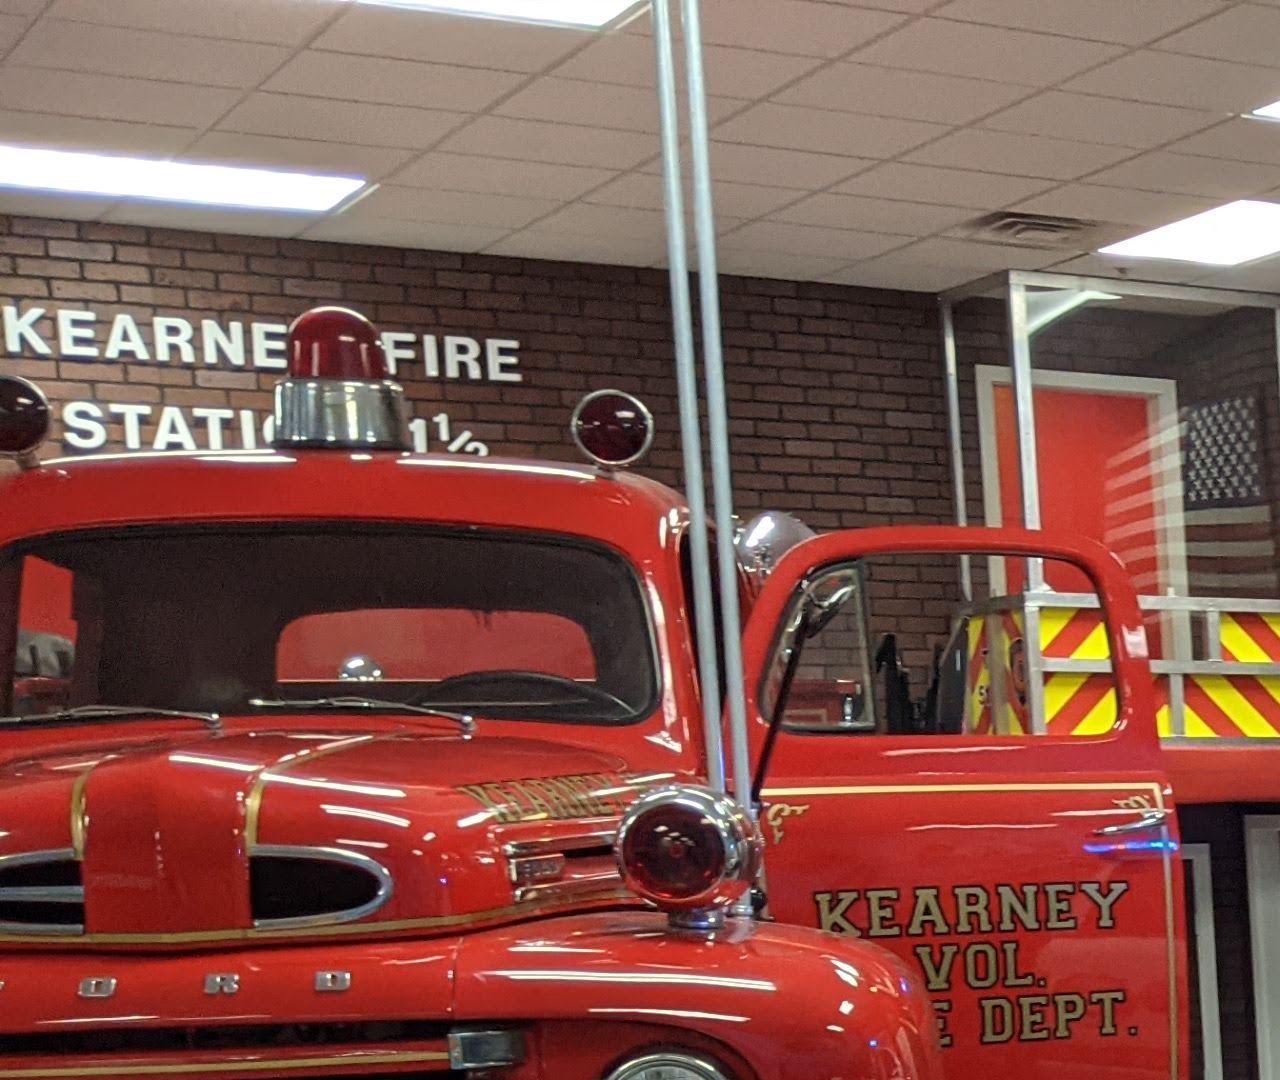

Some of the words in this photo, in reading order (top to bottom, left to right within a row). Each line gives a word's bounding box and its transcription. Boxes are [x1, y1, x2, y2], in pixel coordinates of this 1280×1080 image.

[2, 305, 288, 369] KEARNE
[380, 331, 523, 382] FIRE
[815, 881, 1129, 938] KEARNEY
[914, 942, 1048, 990] VOL.
[980, 991, 1139, 1044] DEPT.
